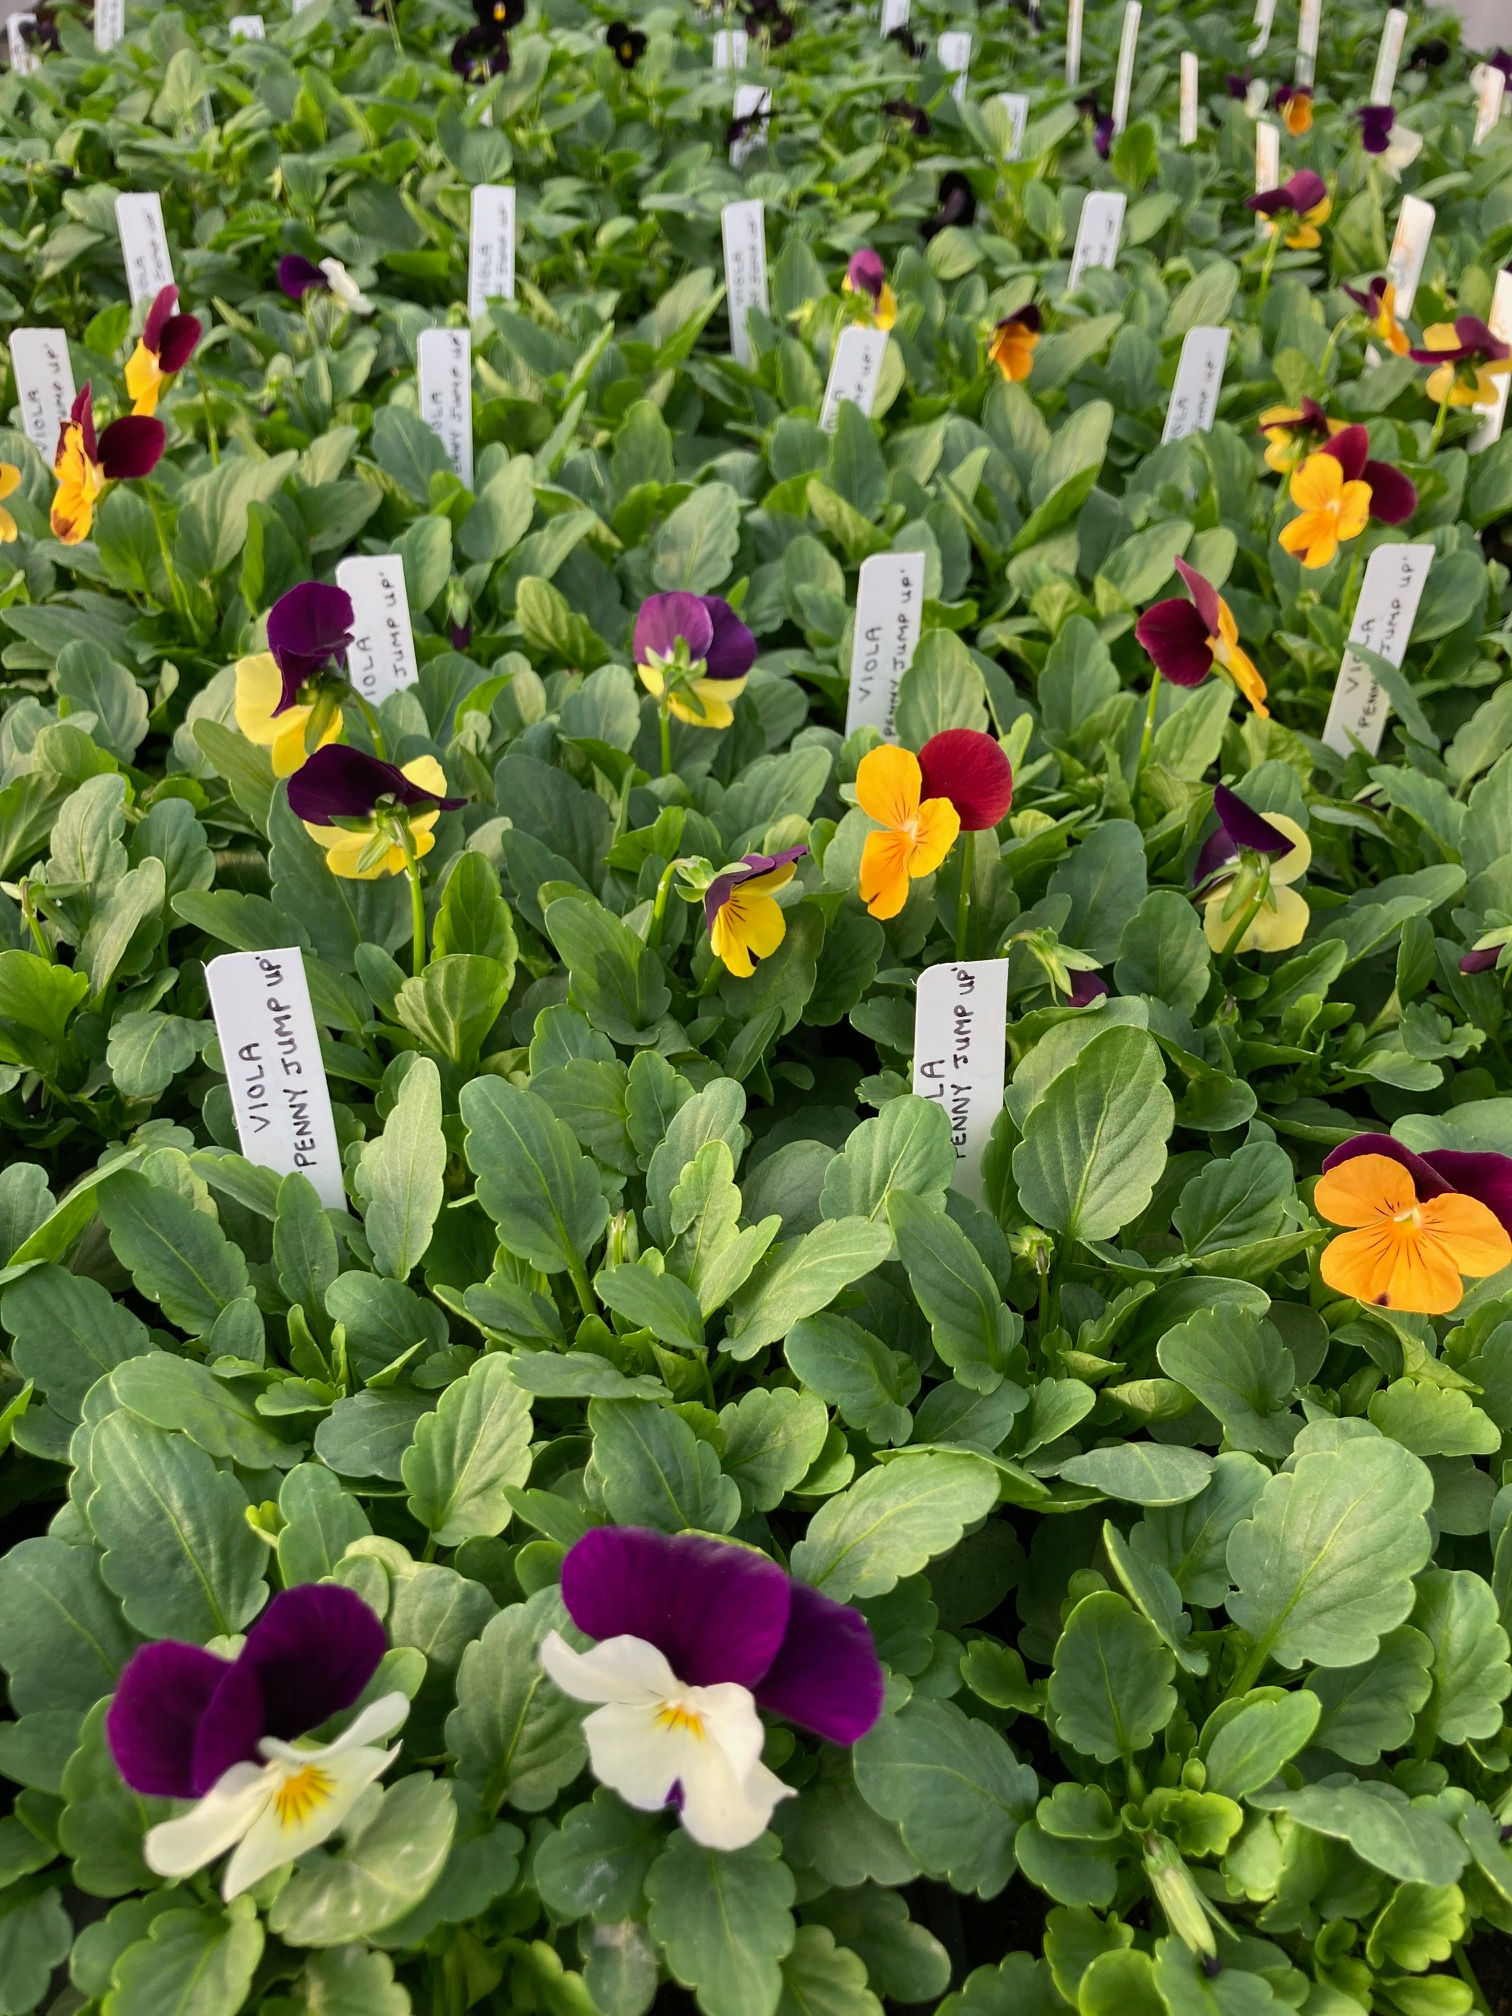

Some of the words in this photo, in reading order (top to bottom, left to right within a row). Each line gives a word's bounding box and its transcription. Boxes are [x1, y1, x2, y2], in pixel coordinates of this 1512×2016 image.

[53, 381, 68, 418] UMP
[431, 390, 444, 432] OLA
[450, 431, 463, 474] ENNY
[356, 636, 376, 697] IOLA
[386, 617, 407, 678] JUMP
[858, 626, 883, 702] VIOLA
[893, 613, 909, 672] JUMP
[267, 997, 302, 1076] JUMP
[953, 1004, 974, 1070] JUMP
[238, 1042, 271, 1133] VIOLA
